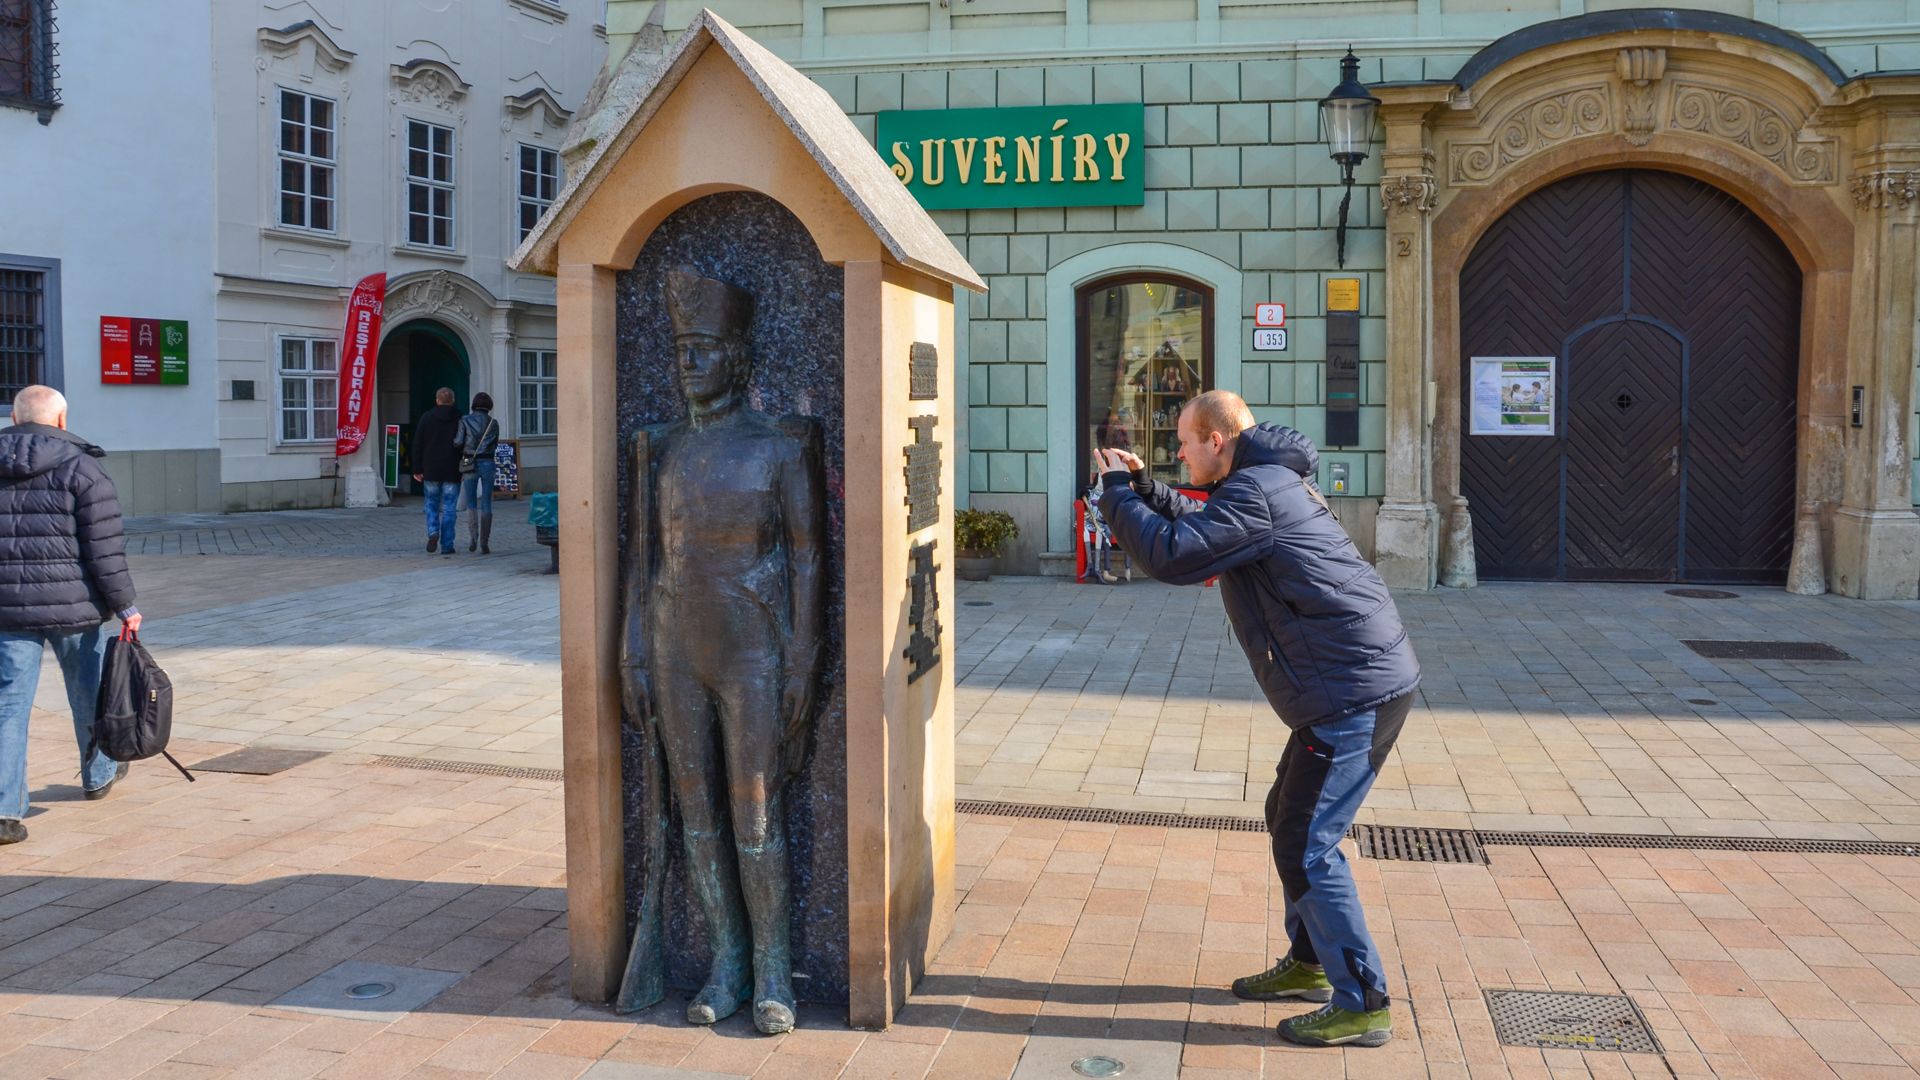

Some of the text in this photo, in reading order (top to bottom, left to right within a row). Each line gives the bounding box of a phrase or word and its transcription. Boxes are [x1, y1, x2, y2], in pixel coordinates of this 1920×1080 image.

[890, 118, 1130, 186] SUVENÍRY
[1397, 238, 1411, 256] 2
[1267, 308, 1274, 321] 2
[347, 310, 371, 423] RESTAURANT
